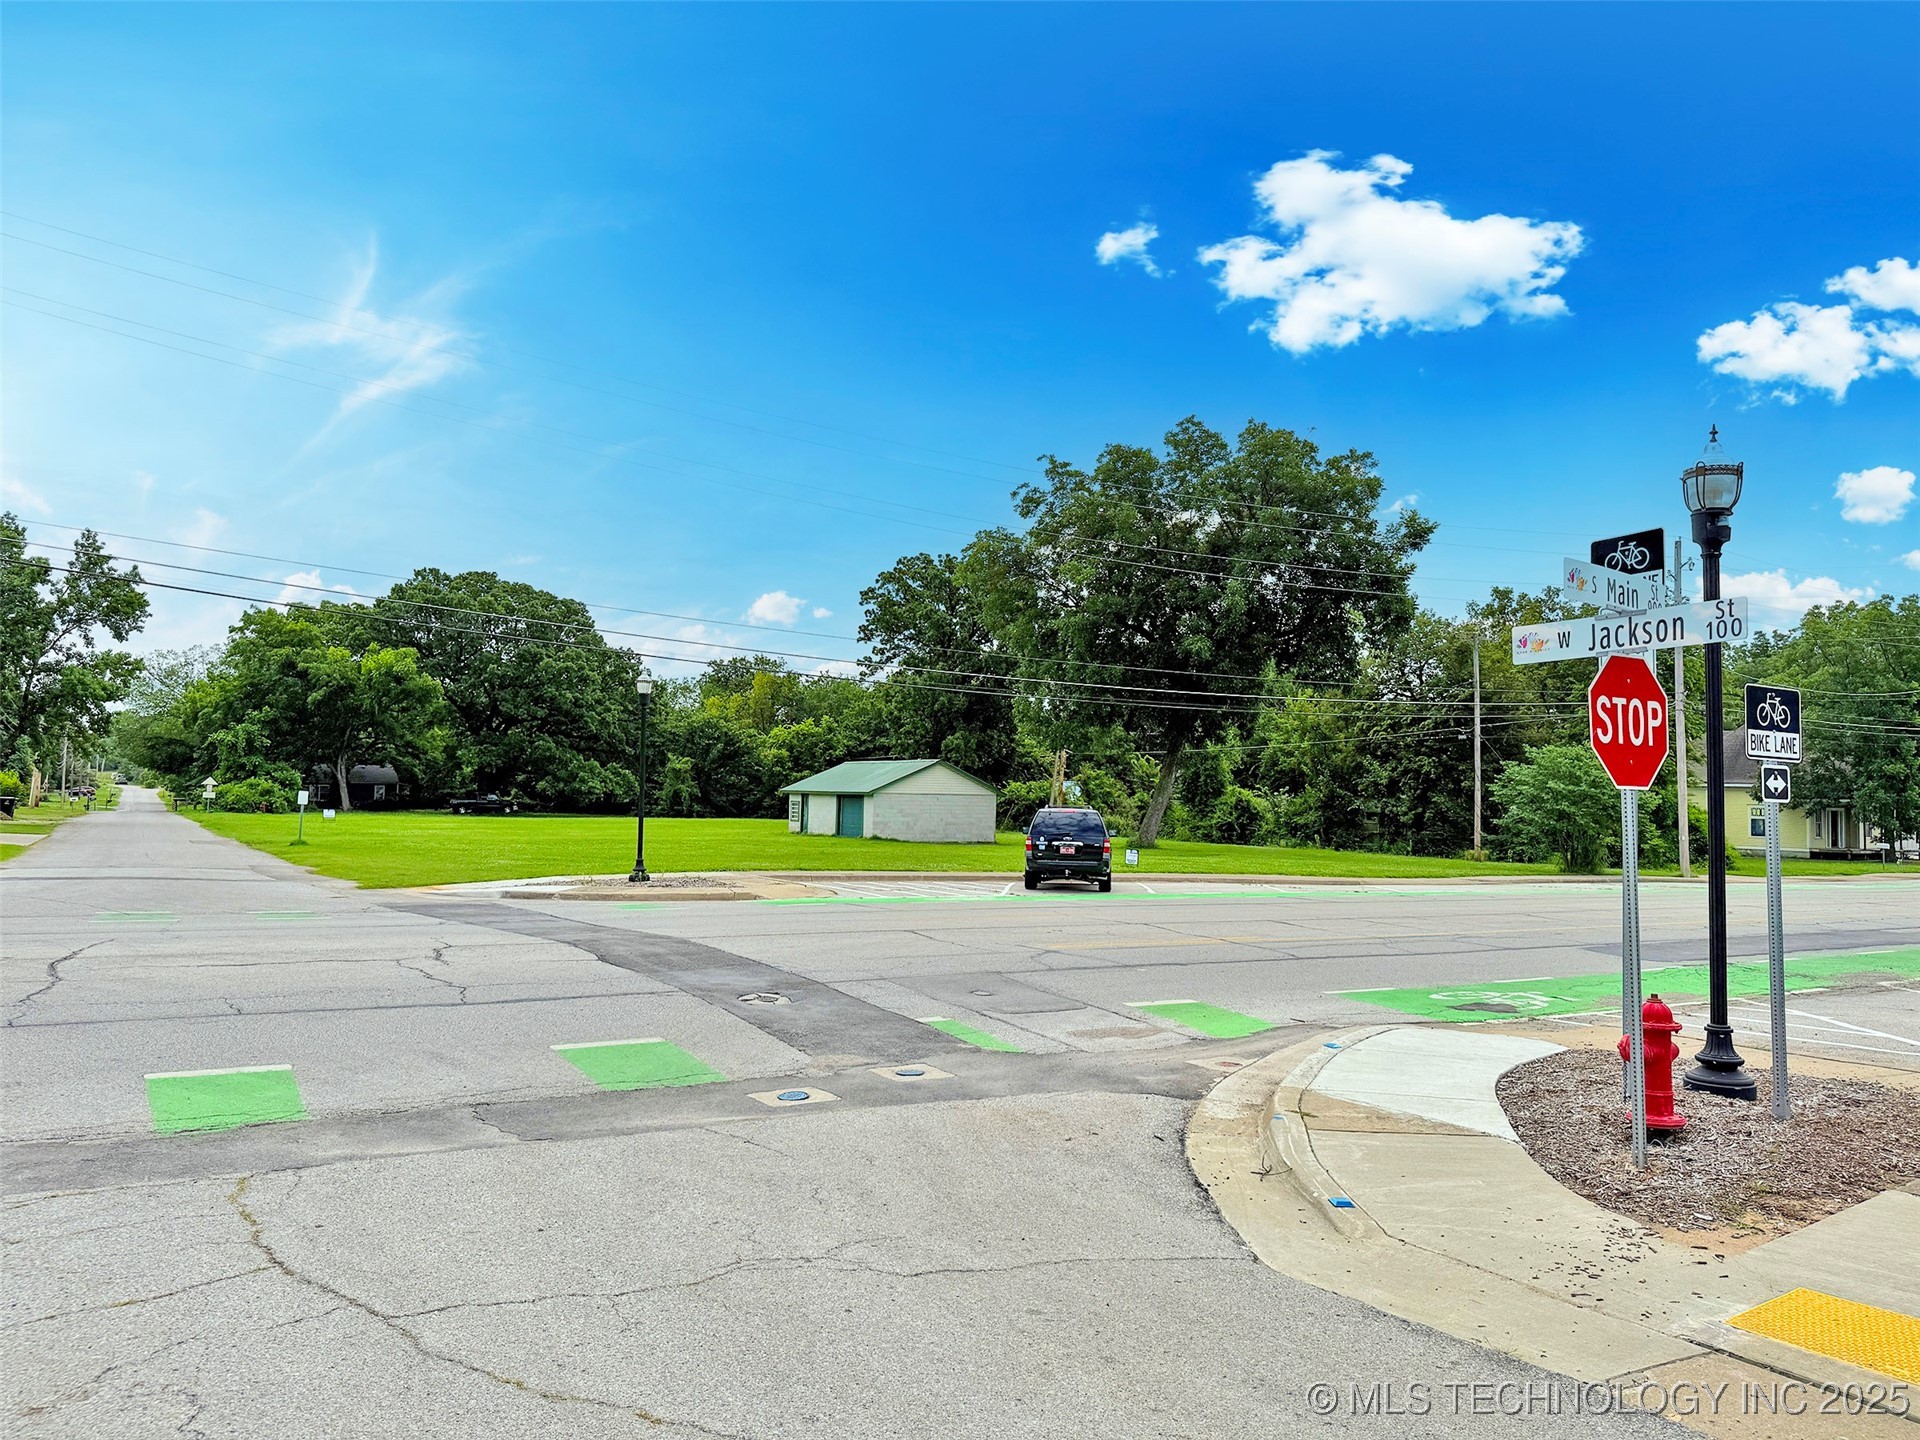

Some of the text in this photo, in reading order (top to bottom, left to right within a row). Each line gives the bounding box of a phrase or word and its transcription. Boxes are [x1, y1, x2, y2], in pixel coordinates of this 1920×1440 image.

[1591, 575, 1597, 594] S
[1607, 577, 1639, 609] Main
[1650, 584, 1659, 602] St
[1557, 598, 1735, 651] W Jackson St
[1706, 617, 1743, 640] 100
[1596, 694, 1663, 747] STOP
[1750, 733, 1798, 755] BIKE LANE
